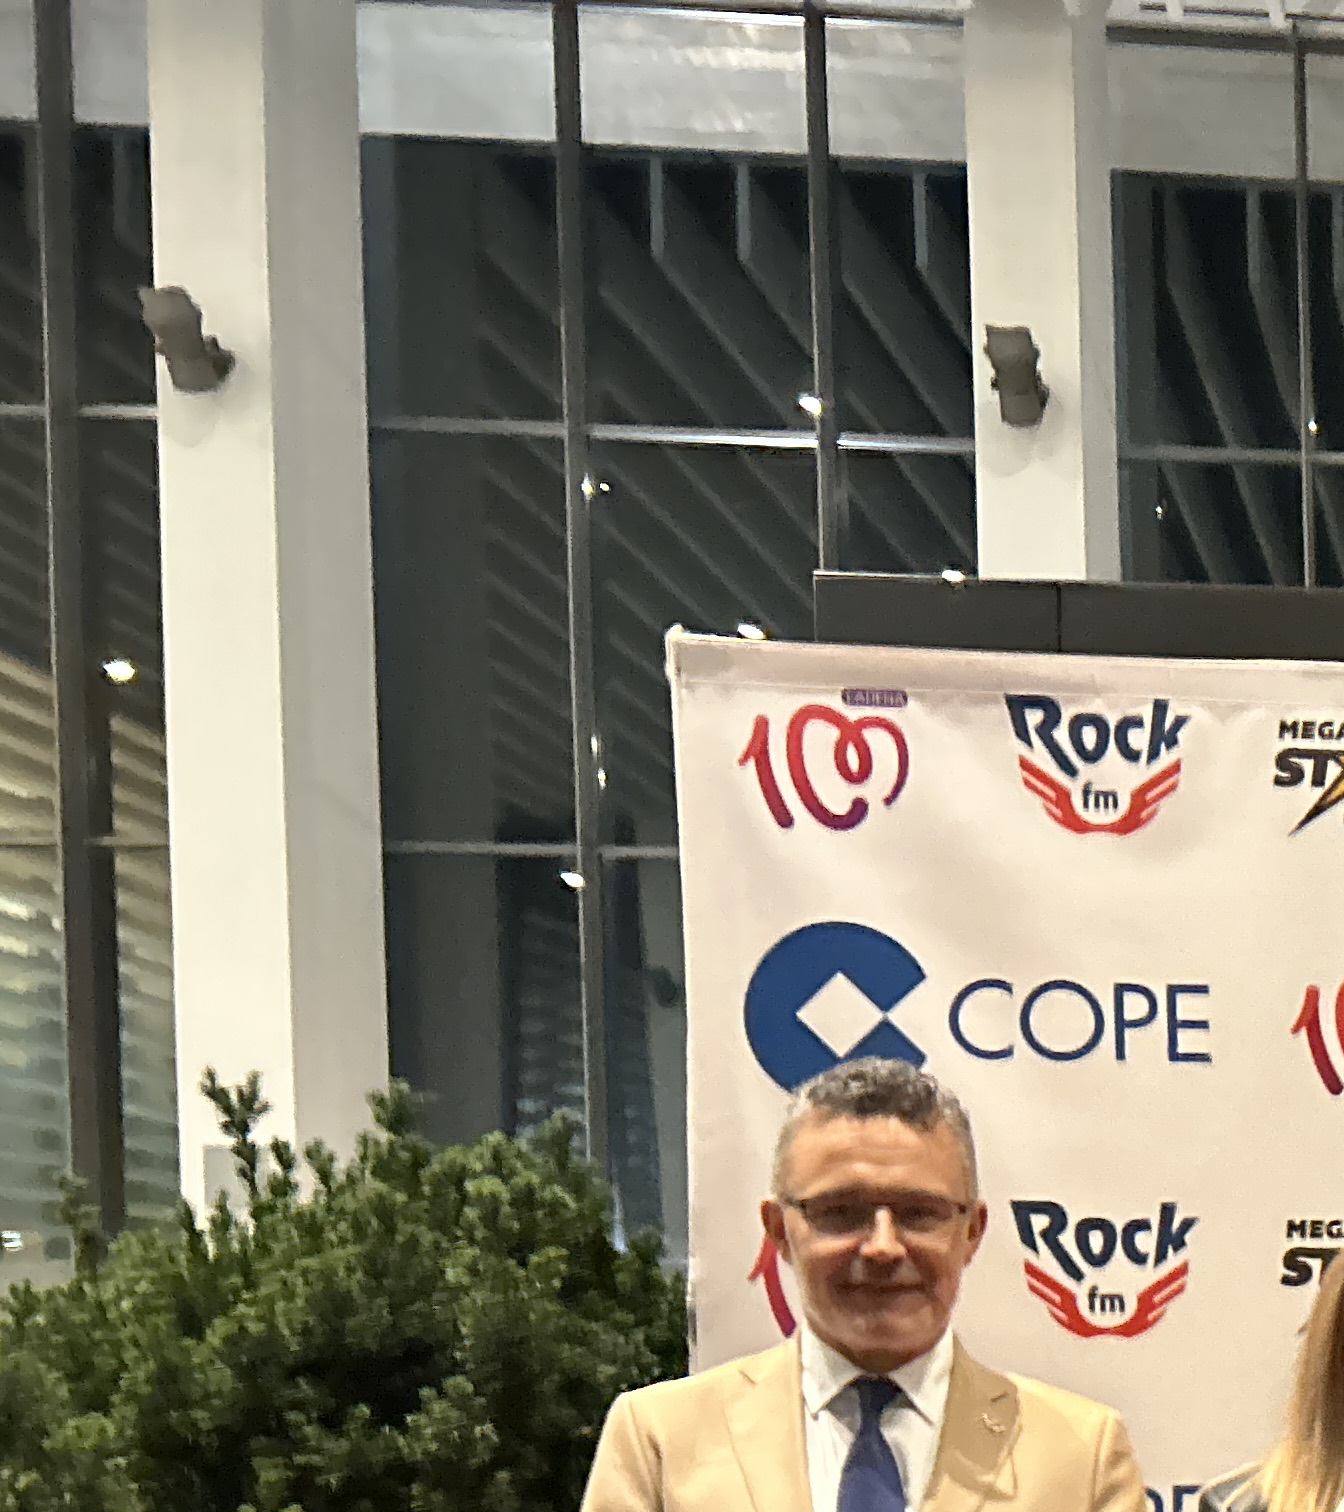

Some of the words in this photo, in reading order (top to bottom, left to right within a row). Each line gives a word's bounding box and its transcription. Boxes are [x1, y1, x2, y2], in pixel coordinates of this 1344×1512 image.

[1005, 694, 1191, 778] Rock
[1082, 783, 1119, 813] fm
[949, 978, 1212, 1062] COPE
[1011, 1200, 1200, 1282] Rock
[1088, 1286, 1125, 1314] fm
